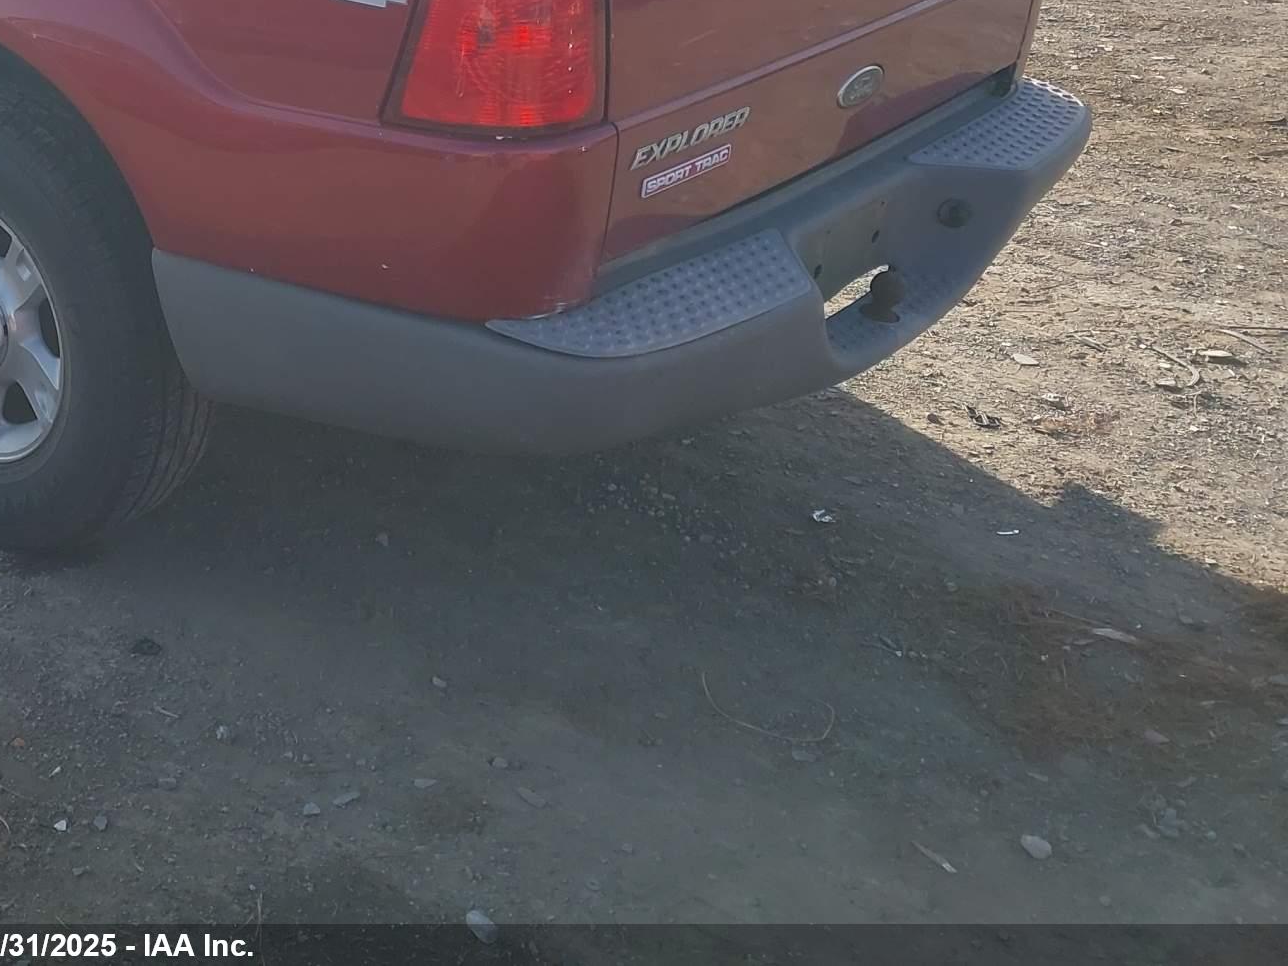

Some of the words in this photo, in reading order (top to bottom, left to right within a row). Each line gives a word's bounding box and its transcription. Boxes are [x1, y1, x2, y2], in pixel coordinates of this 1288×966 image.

[630, 107, 751, 170] EXPLORER
[646, 165, 692, 194] SPORT
[695, 149, 730, 180] TRAC
